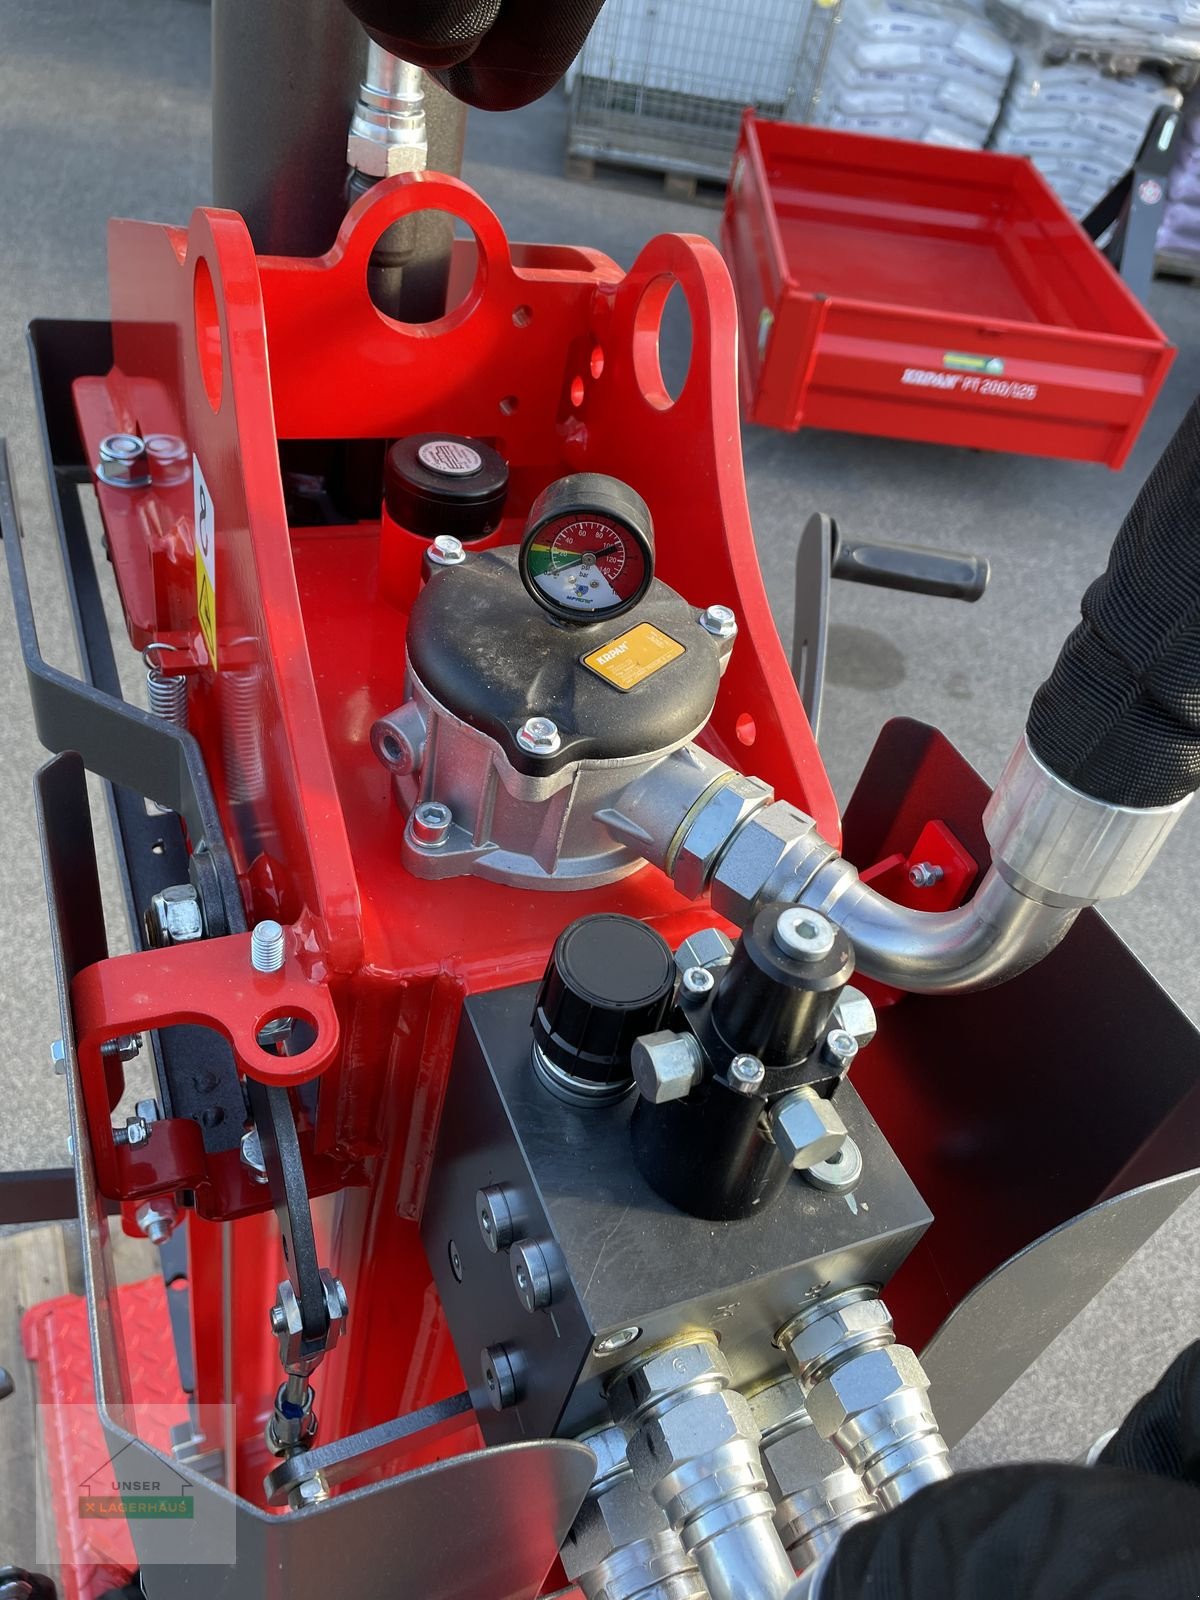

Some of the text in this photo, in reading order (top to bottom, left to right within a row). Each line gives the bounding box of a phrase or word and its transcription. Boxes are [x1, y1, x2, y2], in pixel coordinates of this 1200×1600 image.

[579, 529, 587, 537] 60
[595, 531, 604, 539] 80
[565, 537, 574, 545] 40
[606, 555, 617, 563] 120
[599, 566, 611, 574] 140
[595, 642, 629, 665] KRPAN
